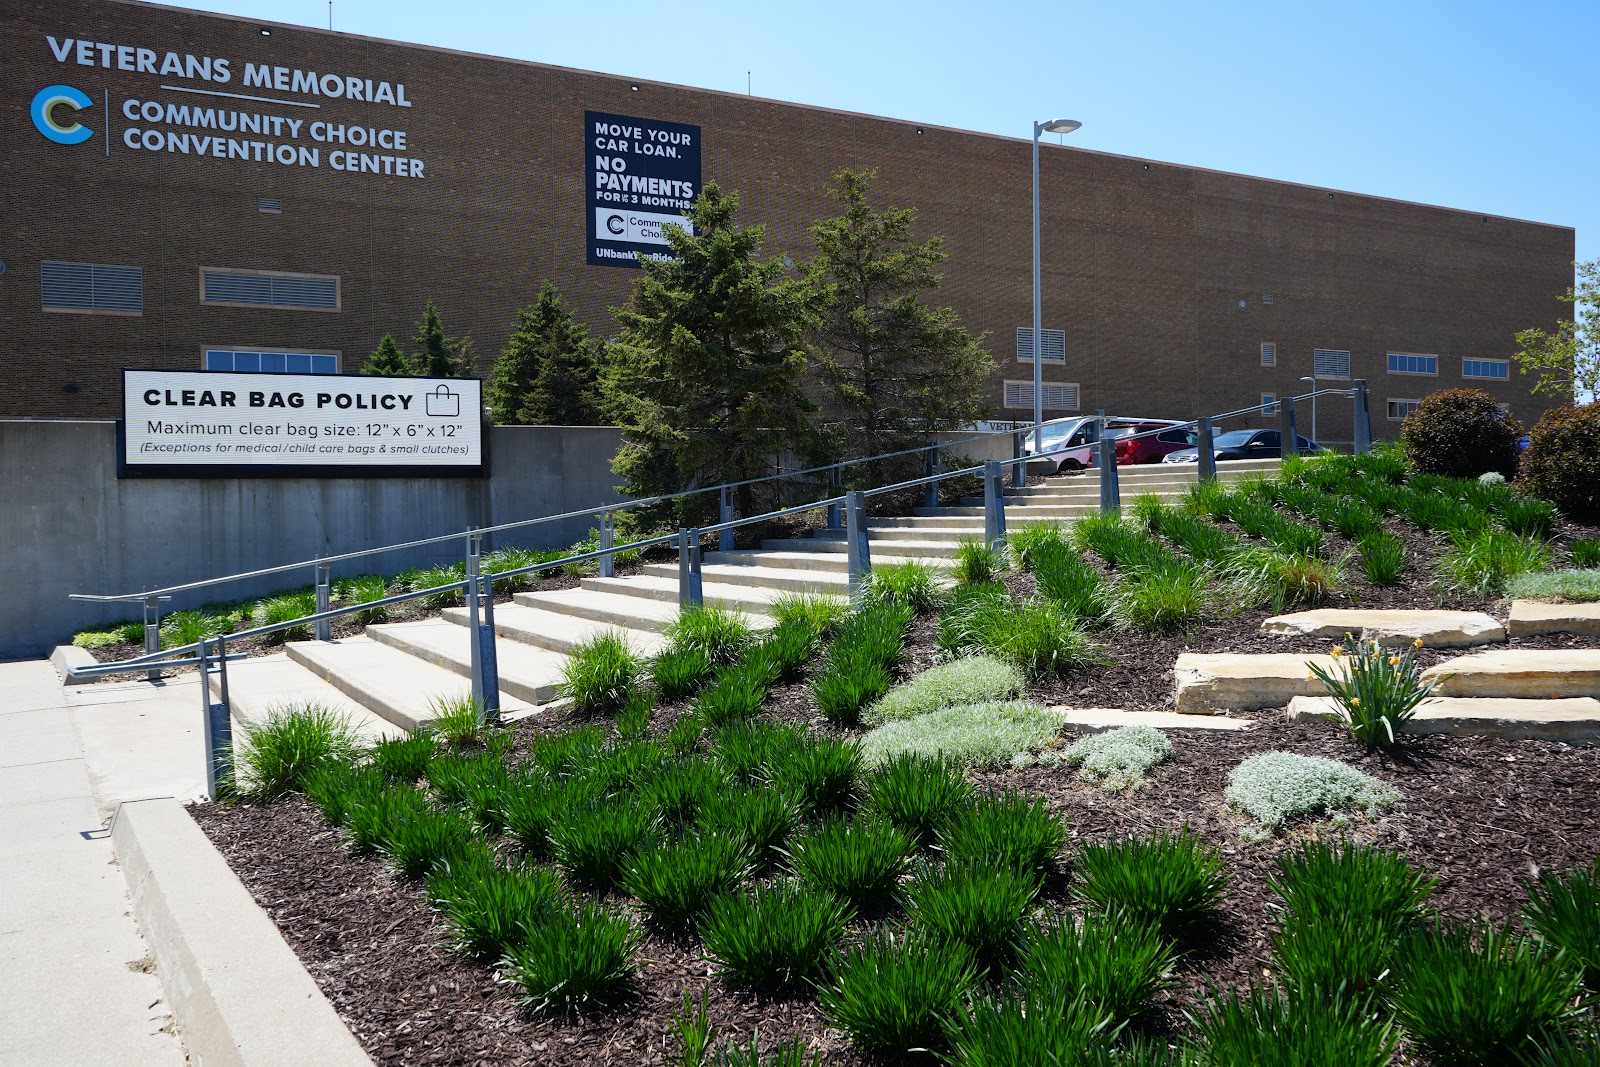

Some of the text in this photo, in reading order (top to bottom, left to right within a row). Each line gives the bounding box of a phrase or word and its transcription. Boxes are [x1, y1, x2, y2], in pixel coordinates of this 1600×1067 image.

[46, 36, 411, 107] VETERANS MEMORIAL
[123, 100, 407, 150] COMMUNITY CHOICE
[595, 122, 691, 146] MOVE YOUR
[124, 128, 425, 178] CONVENTION CENTER
[595, 137, 681, 159] CAR LOAN.
[595, 155, 626, 172] NO
[596, 171, 693, 198] PAYMENTS
[596, 191, 621, 202] FOR
[631, 195, 638, 203] 3
[630, 217, 683, 229] Commity
[641, 229, 668, 239] Choi
[143, 389, 413, 410] CLEAR BAG POLICY
[148, 421, 232, 435] Maximum
[239, 422, 281, 435] clear
[287, 423, 318, 438] bag
[324, 424, 360, 436] size:
[392, 428, 401, 436] x
[426, 427, 435, 437] x
[140, 442, 211, 454] (Exceptions
[216, 443, 232, 453] for
[319, 446, 343, 454] care
[348, 444, 375, 455] bags
[379, 445, 387, 454] &
[390, 445, 419, 454] small
[421, 445, 469, 455] clutches)
